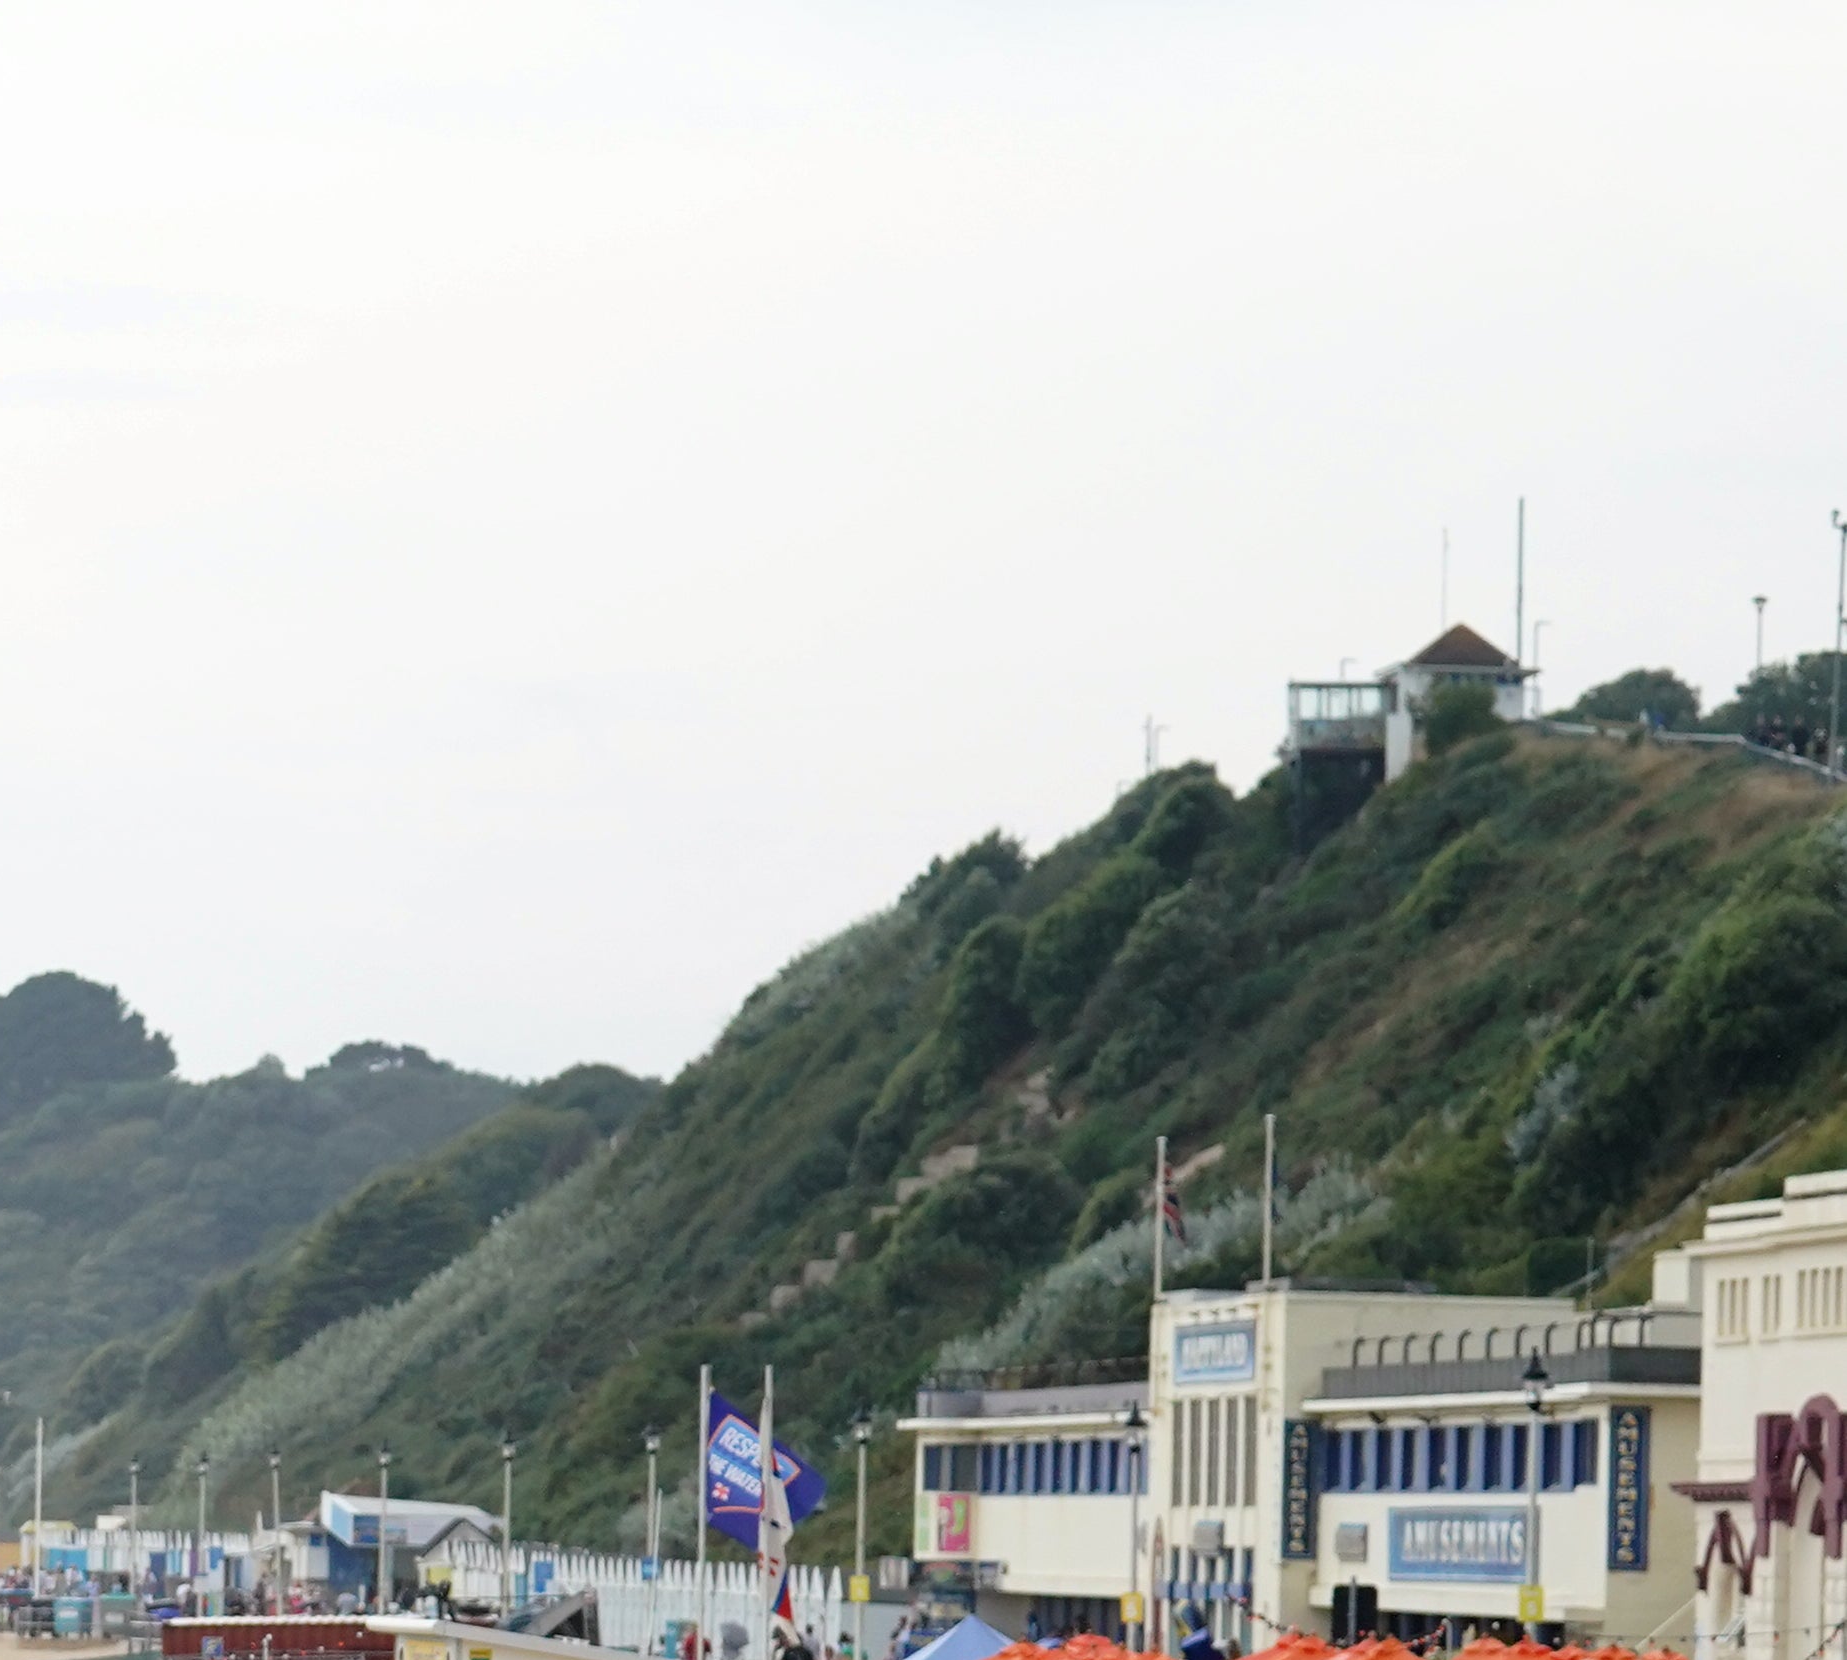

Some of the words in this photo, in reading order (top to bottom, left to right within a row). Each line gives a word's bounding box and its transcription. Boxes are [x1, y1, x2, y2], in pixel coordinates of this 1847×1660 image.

[1287, 1423, 1309, 1553] AMUSEMENTS
[1402, 1520, 1525, 1564] AMUSEMENTS
[1615, 1411, 1639, 1564] AMUSEMENTS
